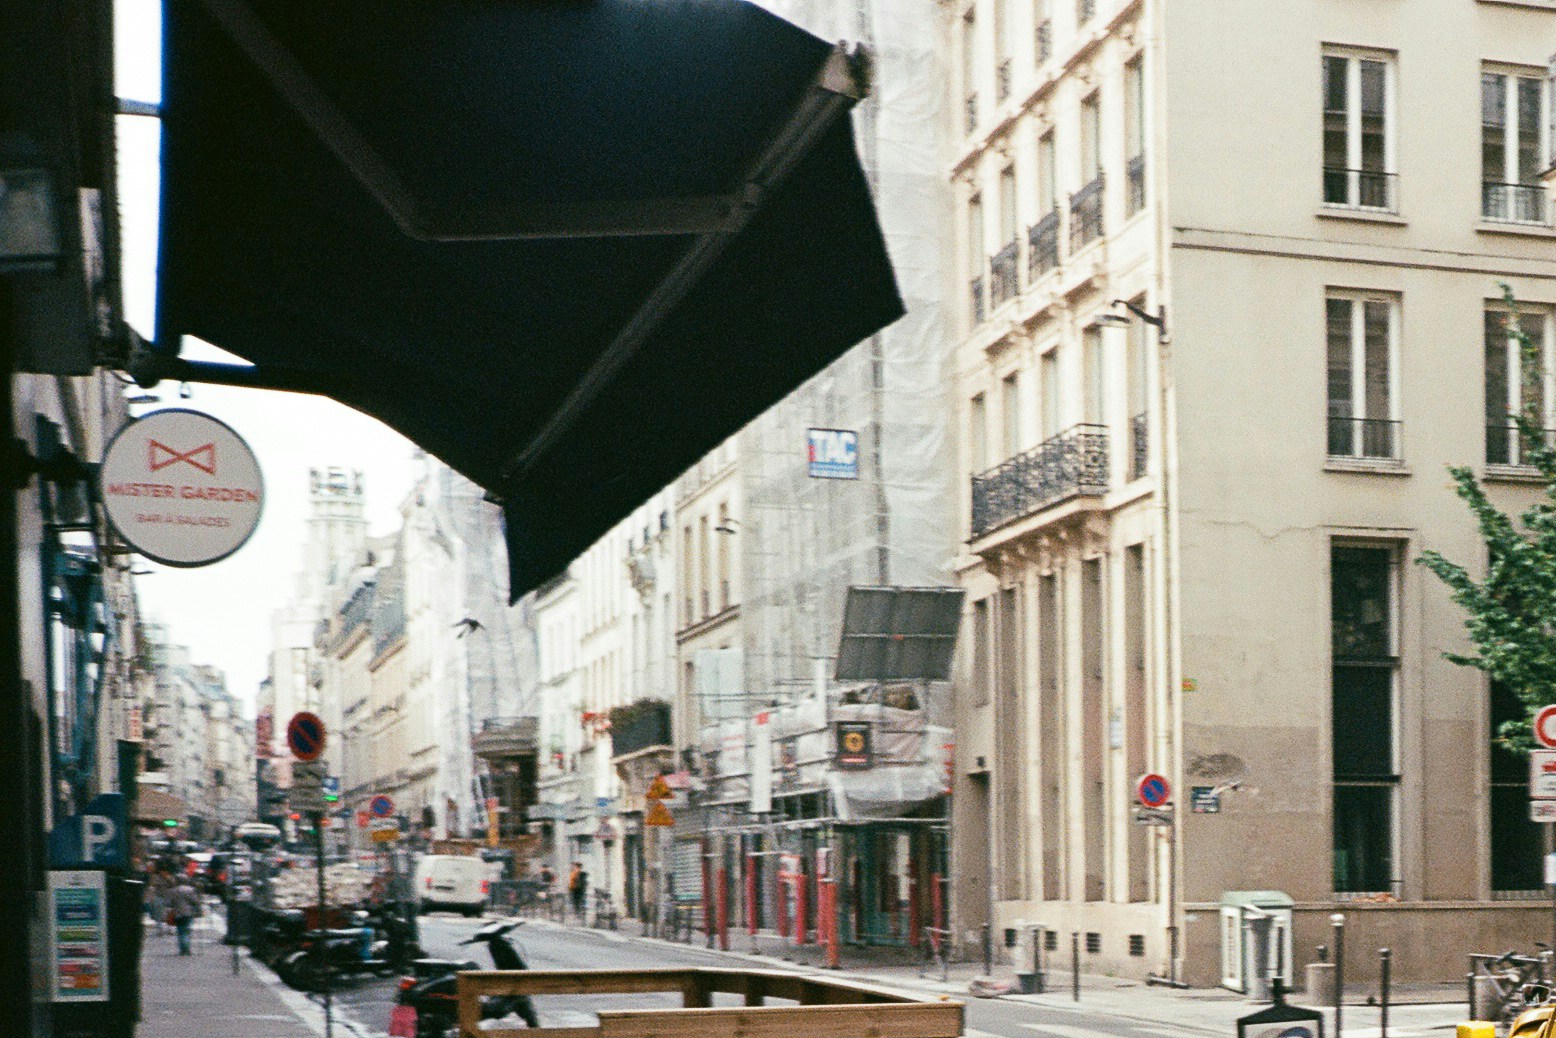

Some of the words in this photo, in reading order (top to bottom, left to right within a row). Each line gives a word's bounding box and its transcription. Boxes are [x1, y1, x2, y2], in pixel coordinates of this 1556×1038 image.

[107, 482, 175, 498] MISTER
[180, 485, 260, 502] GARDEN
[82, 814, 116, 862] P
